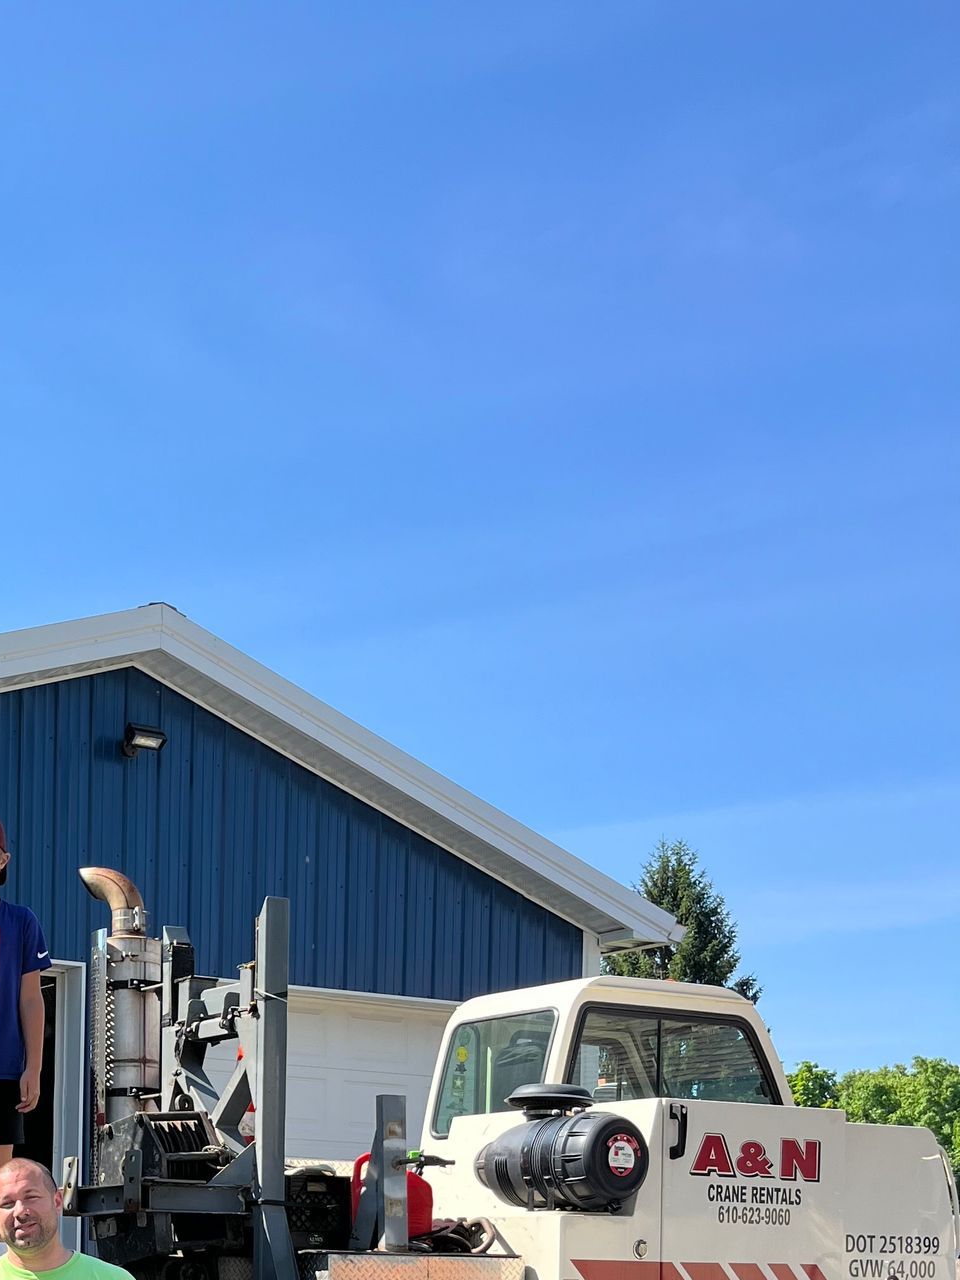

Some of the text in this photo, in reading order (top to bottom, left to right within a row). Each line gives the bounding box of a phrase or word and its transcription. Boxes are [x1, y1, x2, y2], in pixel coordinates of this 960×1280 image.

[689, 1132, 821, 1182] A&N
[707, 1183, 802, 1206] CRANE RENTALS
[718, 1205, 791, 1226] 610-623-9060
[845, 1234, 941, 1255] DOT 2518399
[848, 1258, 936, 1280] GVW 64,000
